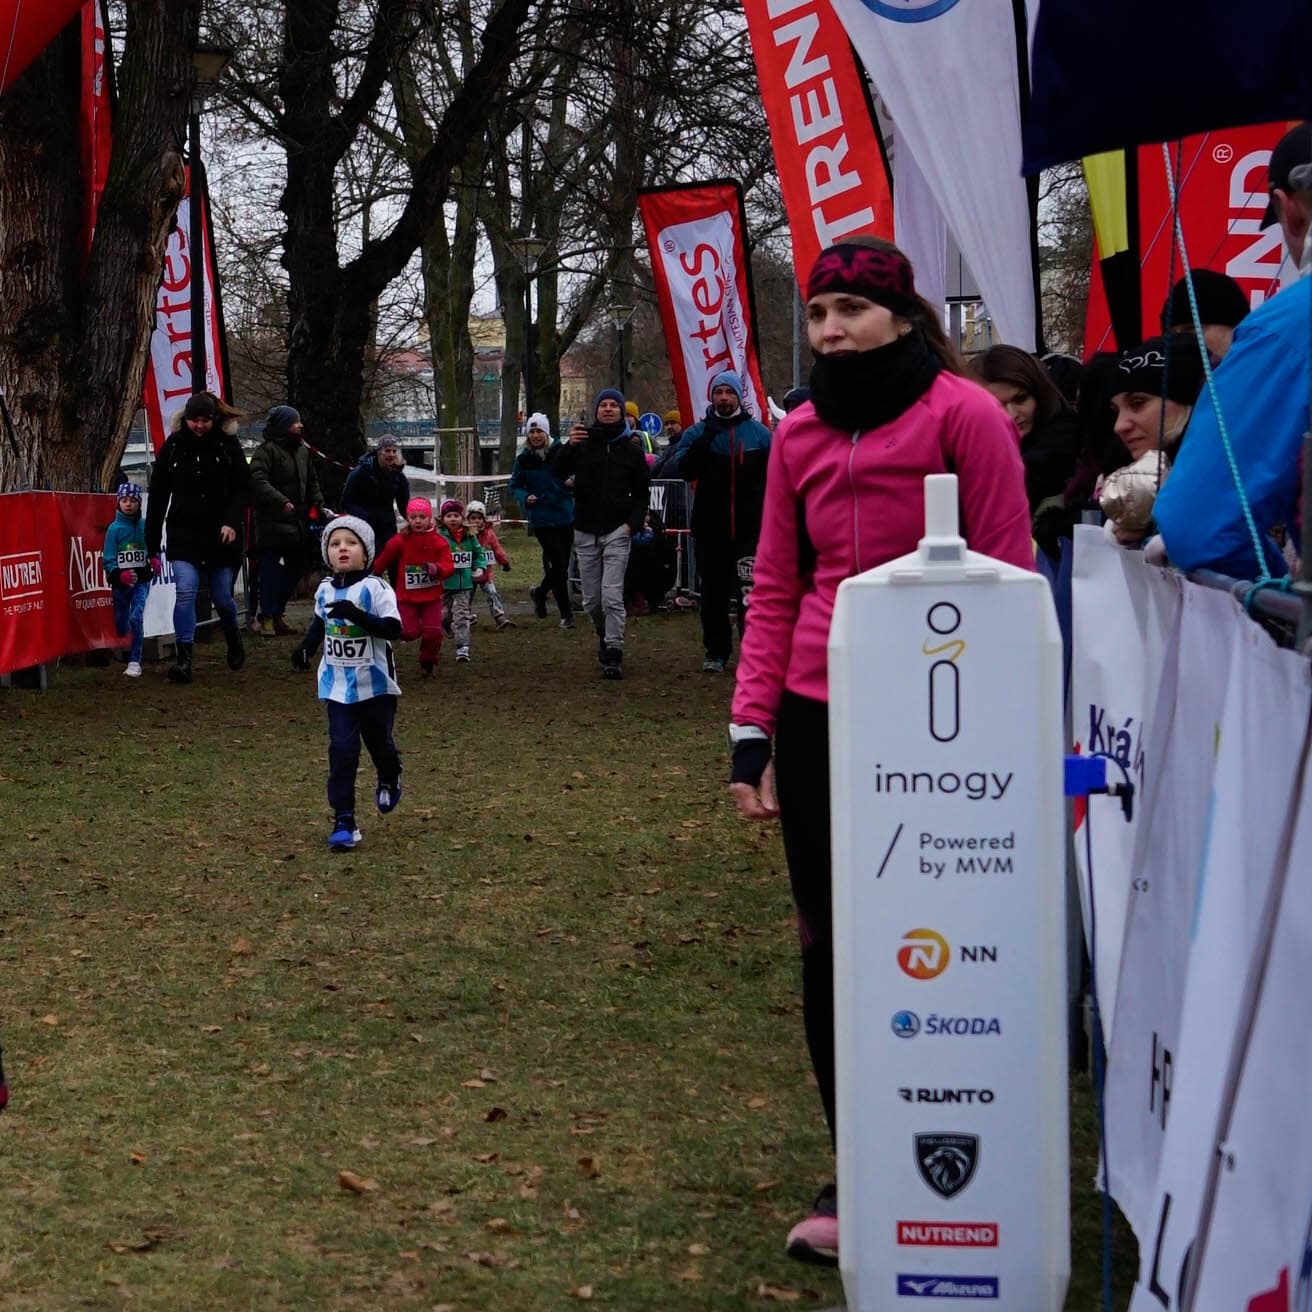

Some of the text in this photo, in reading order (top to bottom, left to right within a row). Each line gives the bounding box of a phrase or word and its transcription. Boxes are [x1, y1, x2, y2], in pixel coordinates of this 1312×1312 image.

[118, 550, 145, 564] 3083
[453, 551, 471, 563] 064
[326, 639, 367, 658] 3067
[875, 764, 1013, 800] innogy
[919, 832, 1015, 850] Powered
[919, 857, 1014, 879] by MVM
[960, 946, 997, 962] NN
[924, 1014, 1001, 1035] ŠKODA
[901, 1226, 994, 1242] NUTREND
